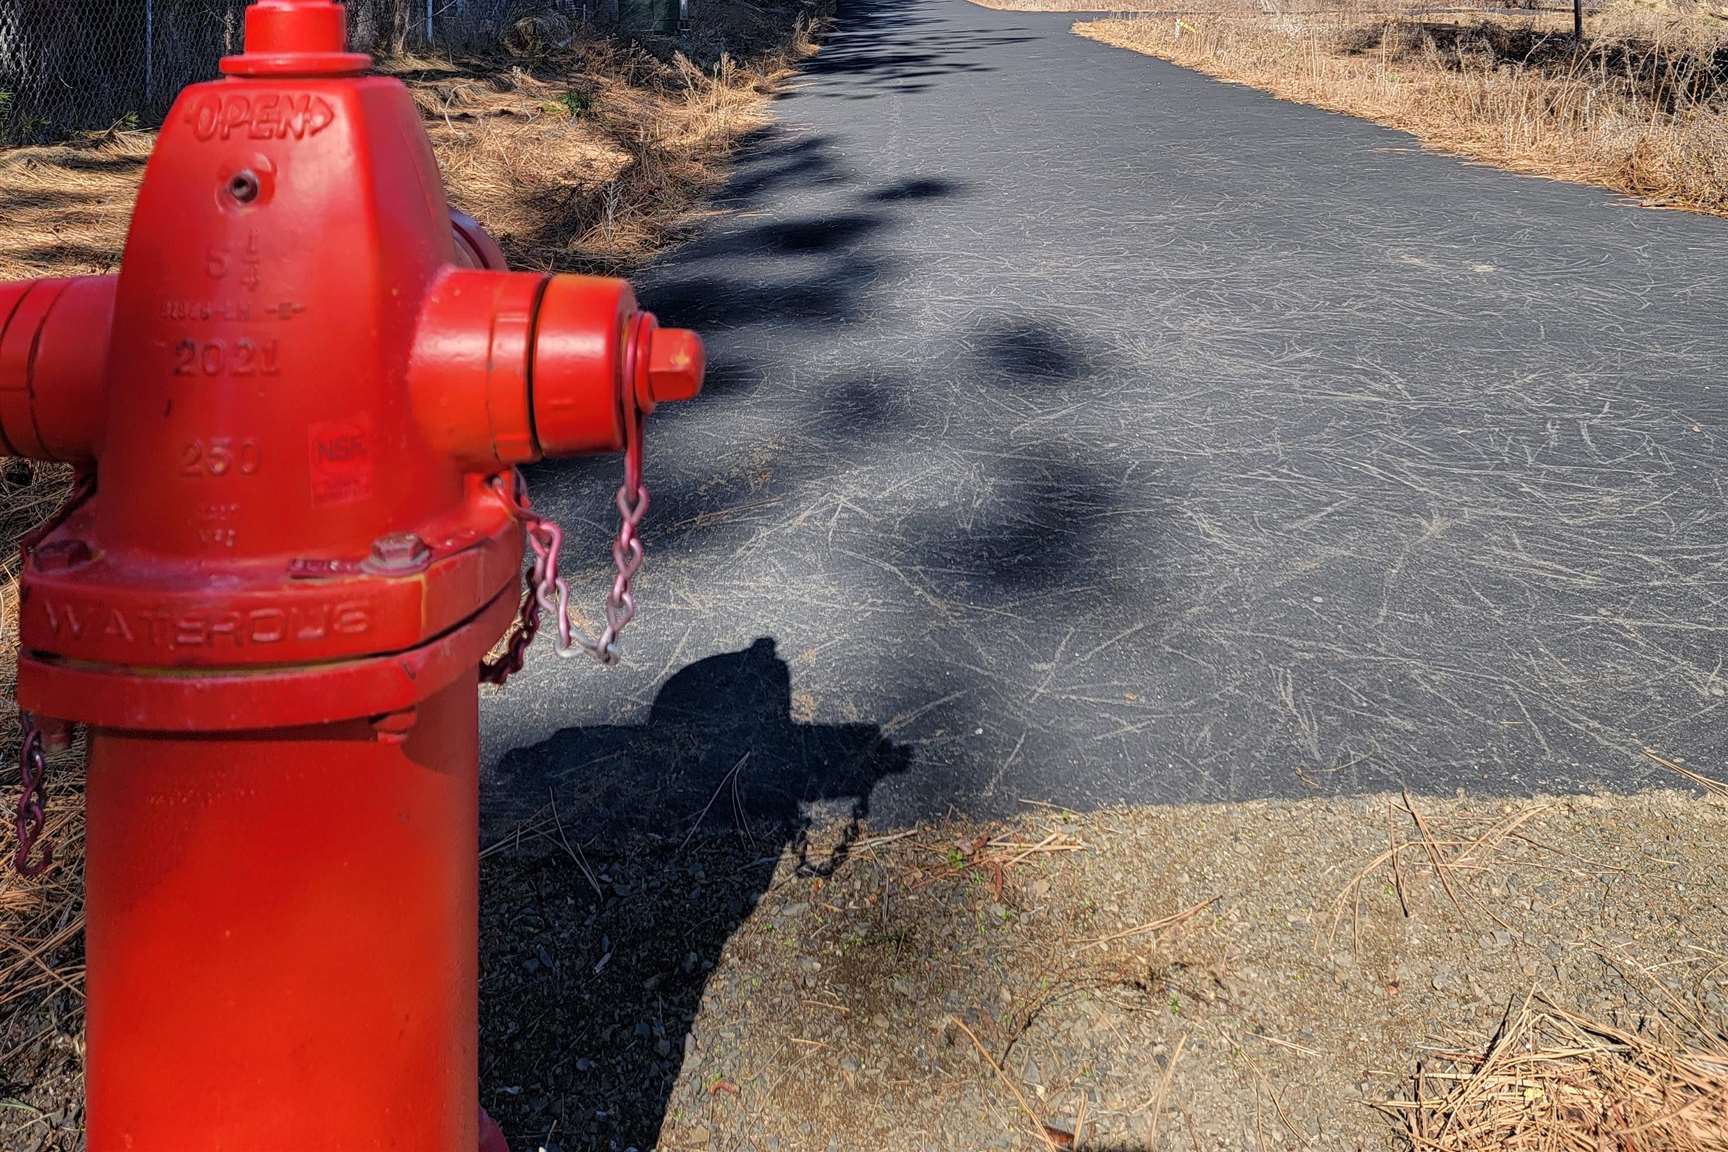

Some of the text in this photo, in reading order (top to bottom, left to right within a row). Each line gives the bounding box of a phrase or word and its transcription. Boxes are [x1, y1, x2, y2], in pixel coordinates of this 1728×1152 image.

[193, 94, 311, 143] OPEN
[172, 330, 280, 378] 2021
[178, 435, 263, 478] 250
[44, 600, 371, 648] WATEROUS
